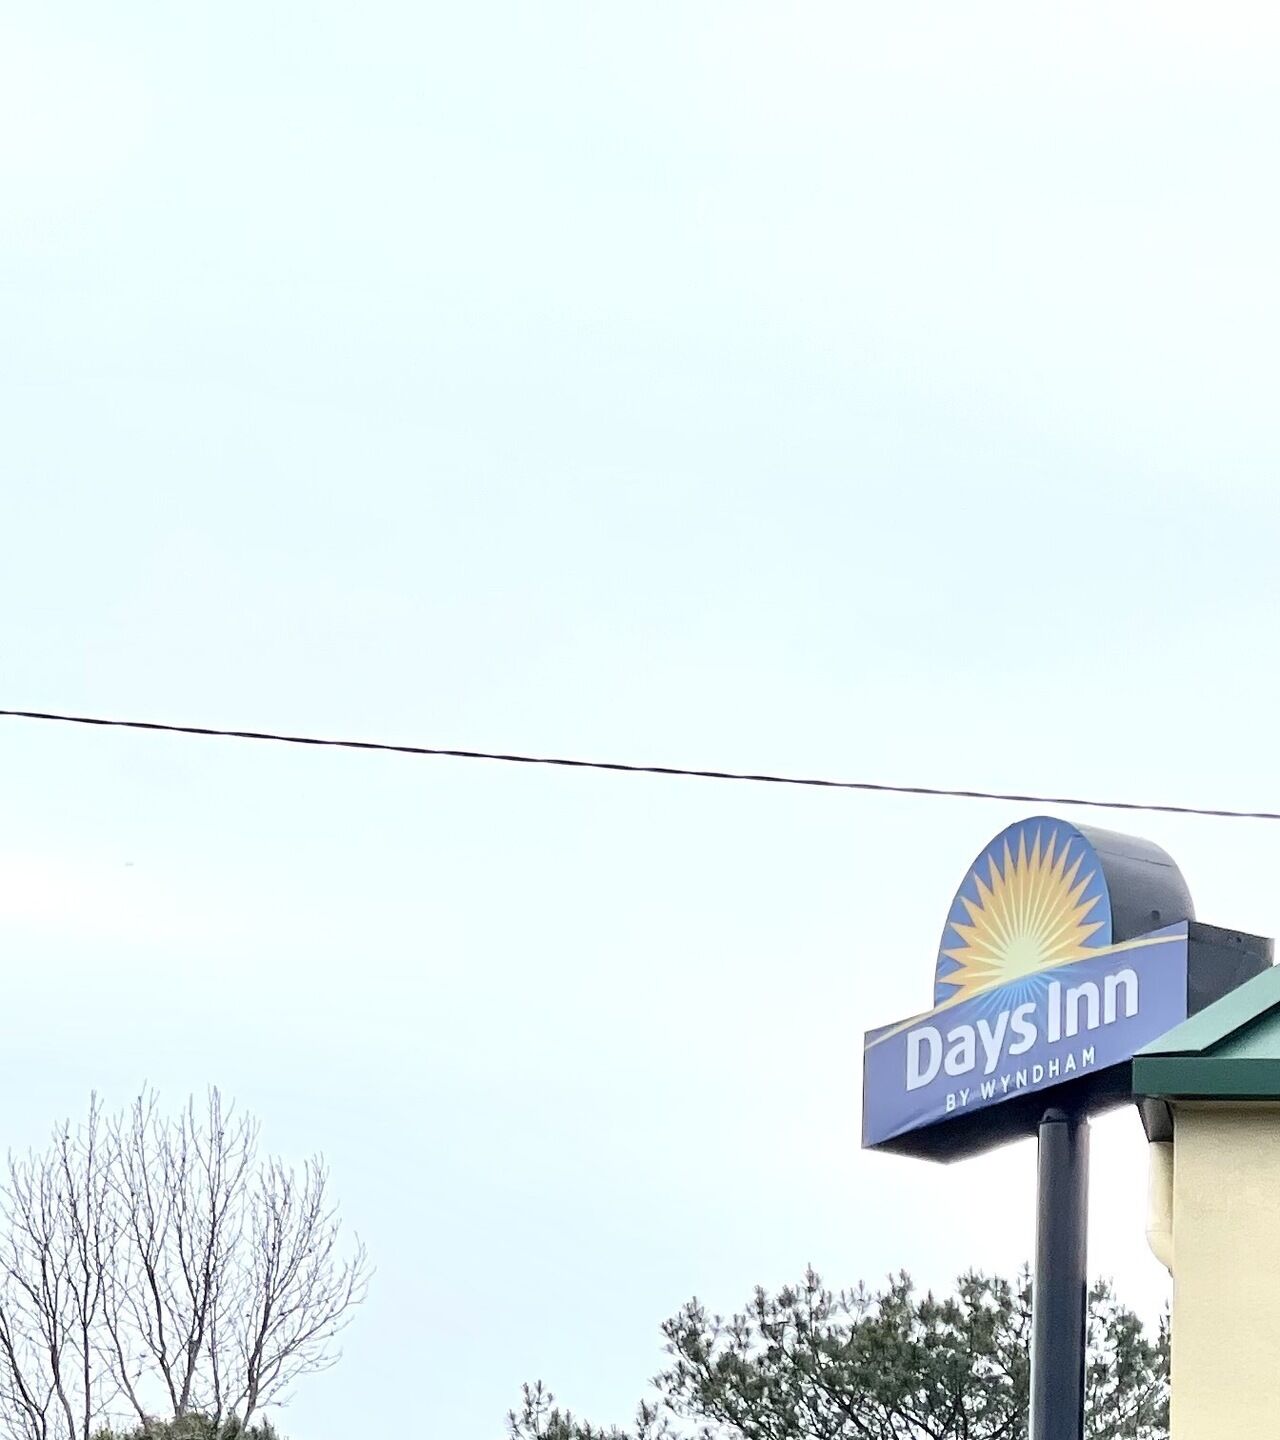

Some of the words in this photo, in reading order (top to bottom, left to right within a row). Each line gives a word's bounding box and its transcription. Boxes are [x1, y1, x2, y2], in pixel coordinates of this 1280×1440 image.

[906, 1000, 1037, 1091] Days
[1047, 968, 1139, 1044] Inn
[945, 1088, 971, 1112] BY
[981, 1046, 1096, 1101] WYNDHAM
